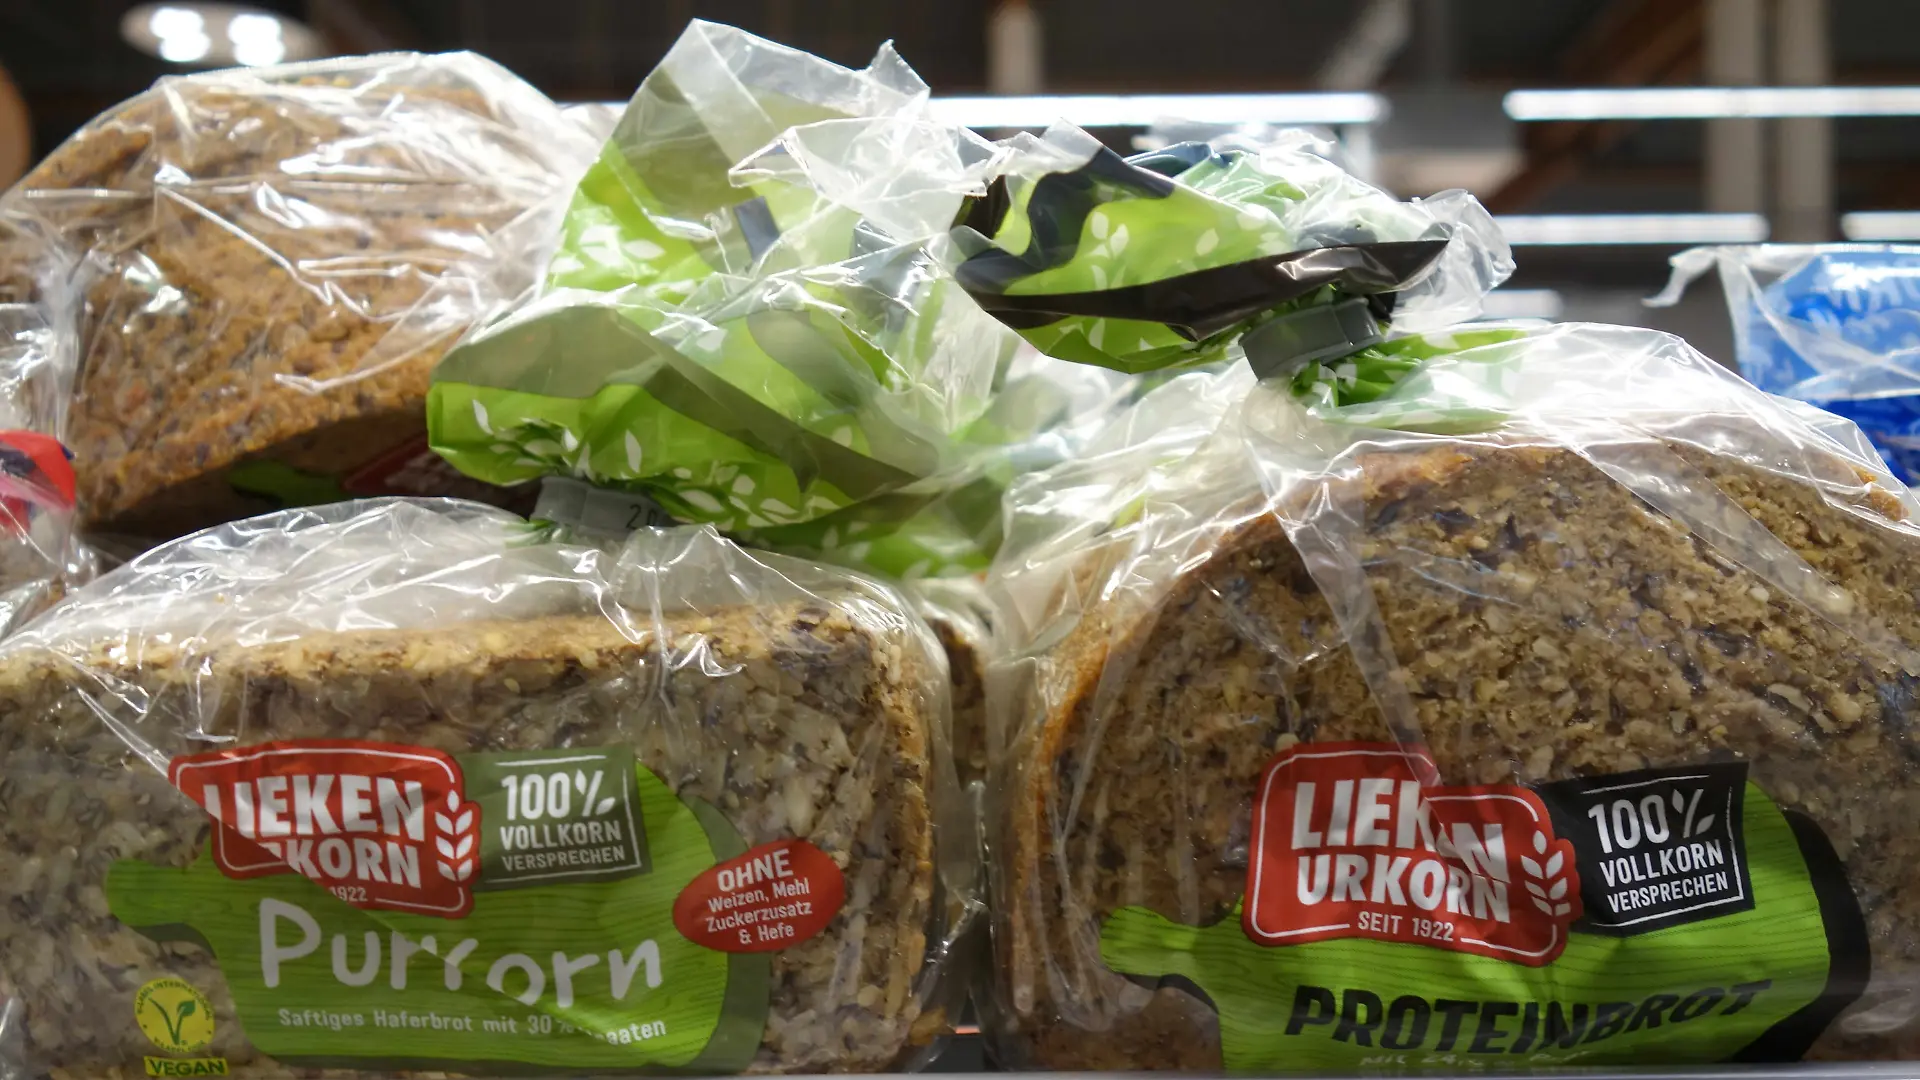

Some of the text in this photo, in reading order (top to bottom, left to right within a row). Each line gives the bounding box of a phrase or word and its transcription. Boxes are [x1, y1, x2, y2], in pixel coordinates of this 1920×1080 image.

[501, 768, 616, 821] 100%
[500, 820, 622, 851] VOLLKORN
[1291, 778, 1511, 883] LIEKN
[1588, 788, 1716, 854] 100%
[258, 837, 421, 889] KORN
[502, 845, 625, 872] VERSPRECHEN
[717, 848, 793, 892] OHNE
[1599, 838, 1724, 888] VOLLKORN
[707, 877, 810, 913] Weizen, Mehl
[1297, 853, 1510, 923] URKORN
[1607, 871, 1729, 913] VERSPRECHEN
[705, 901, 813, 933] Zuckerzusatz
[738, 922, 795, 945] & Hefe
[1358, 911, 1454, 942] SEIT 1922
[279, 1009, 364, 1031] Saftiges
[374, 1010, 473, 1032] Haferbrot
[483, 1016, 517, 1034] mit
[528, 1015, 552, 1035] 30
[1284, 979, 1772, 1055] PROTEINBROT
[148, 1058, 225, 1076] VEGAN
